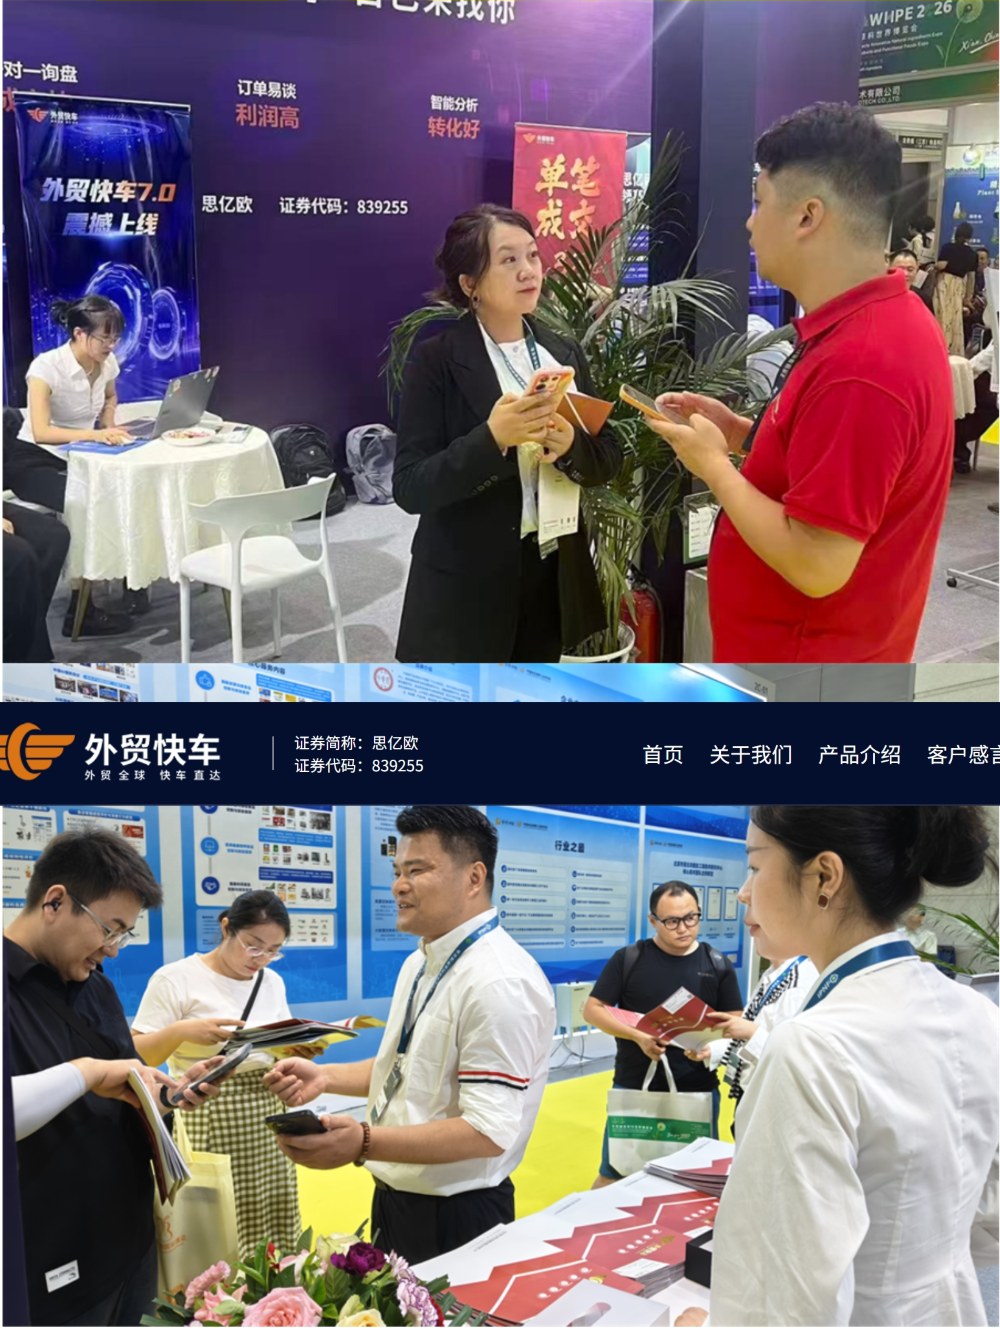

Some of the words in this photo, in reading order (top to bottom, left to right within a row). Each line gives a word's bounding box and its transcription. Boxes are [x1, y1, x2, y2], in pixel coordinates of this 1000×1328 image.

[237, 79, 297, 100] 订单易谈
[430, 94, 479, 113] 智能分析
[235, 102, 300, 130] 利润高
[428, 116, 481, 140] 转化好
[535, 153, 601, 195] 单笔
[40, 177, 177, 205] 外贸快车7.0
[201, 195, 253, 214] 思亿欧
[279, 196, 409, 215] 证券代码：839255
[62, 211, 159, 237] 震撼上线
